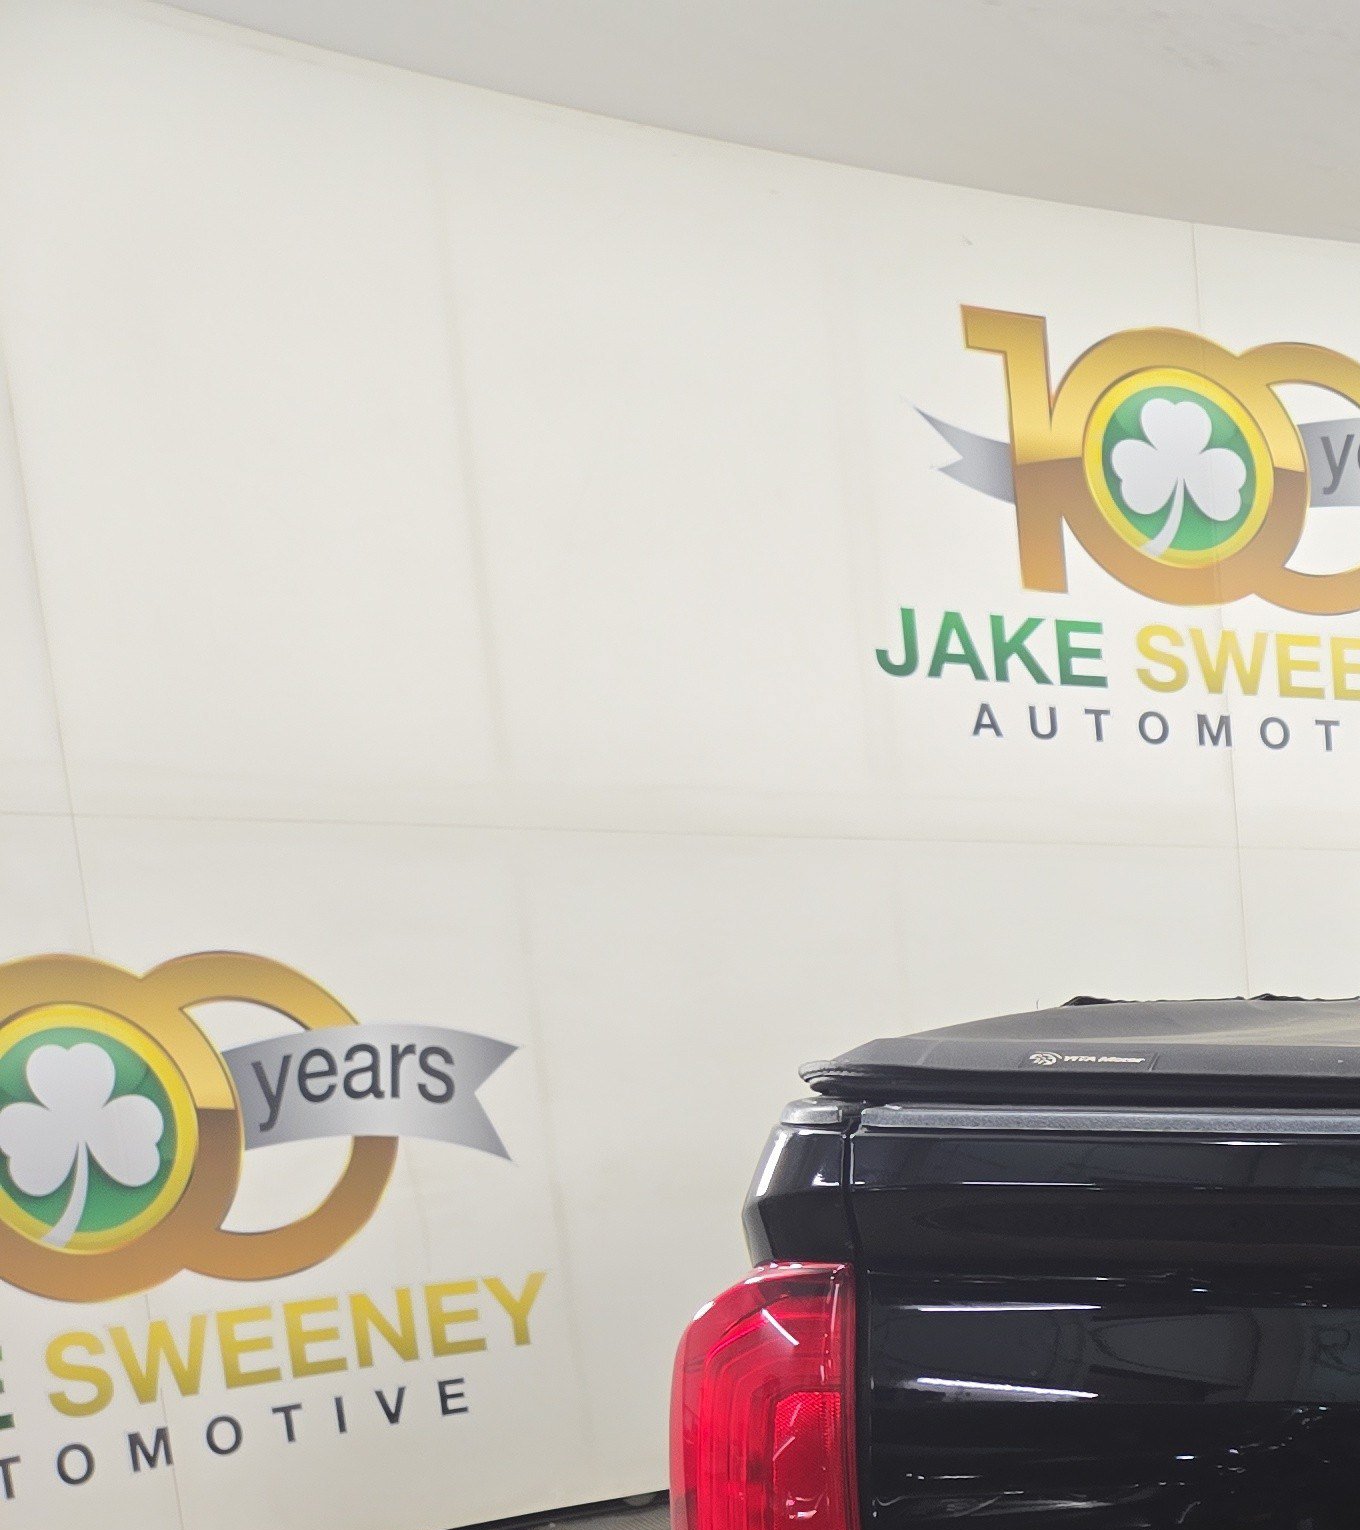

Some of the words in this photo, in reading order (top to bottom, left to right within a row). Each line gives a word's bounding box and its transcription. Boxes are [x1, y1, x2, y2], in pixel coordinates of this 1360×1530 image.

[876, 607, 1108, 689] JAKE
[251, 1041, 457, 1132] years
[45, 1272, 547, 1417] SWEENEY
